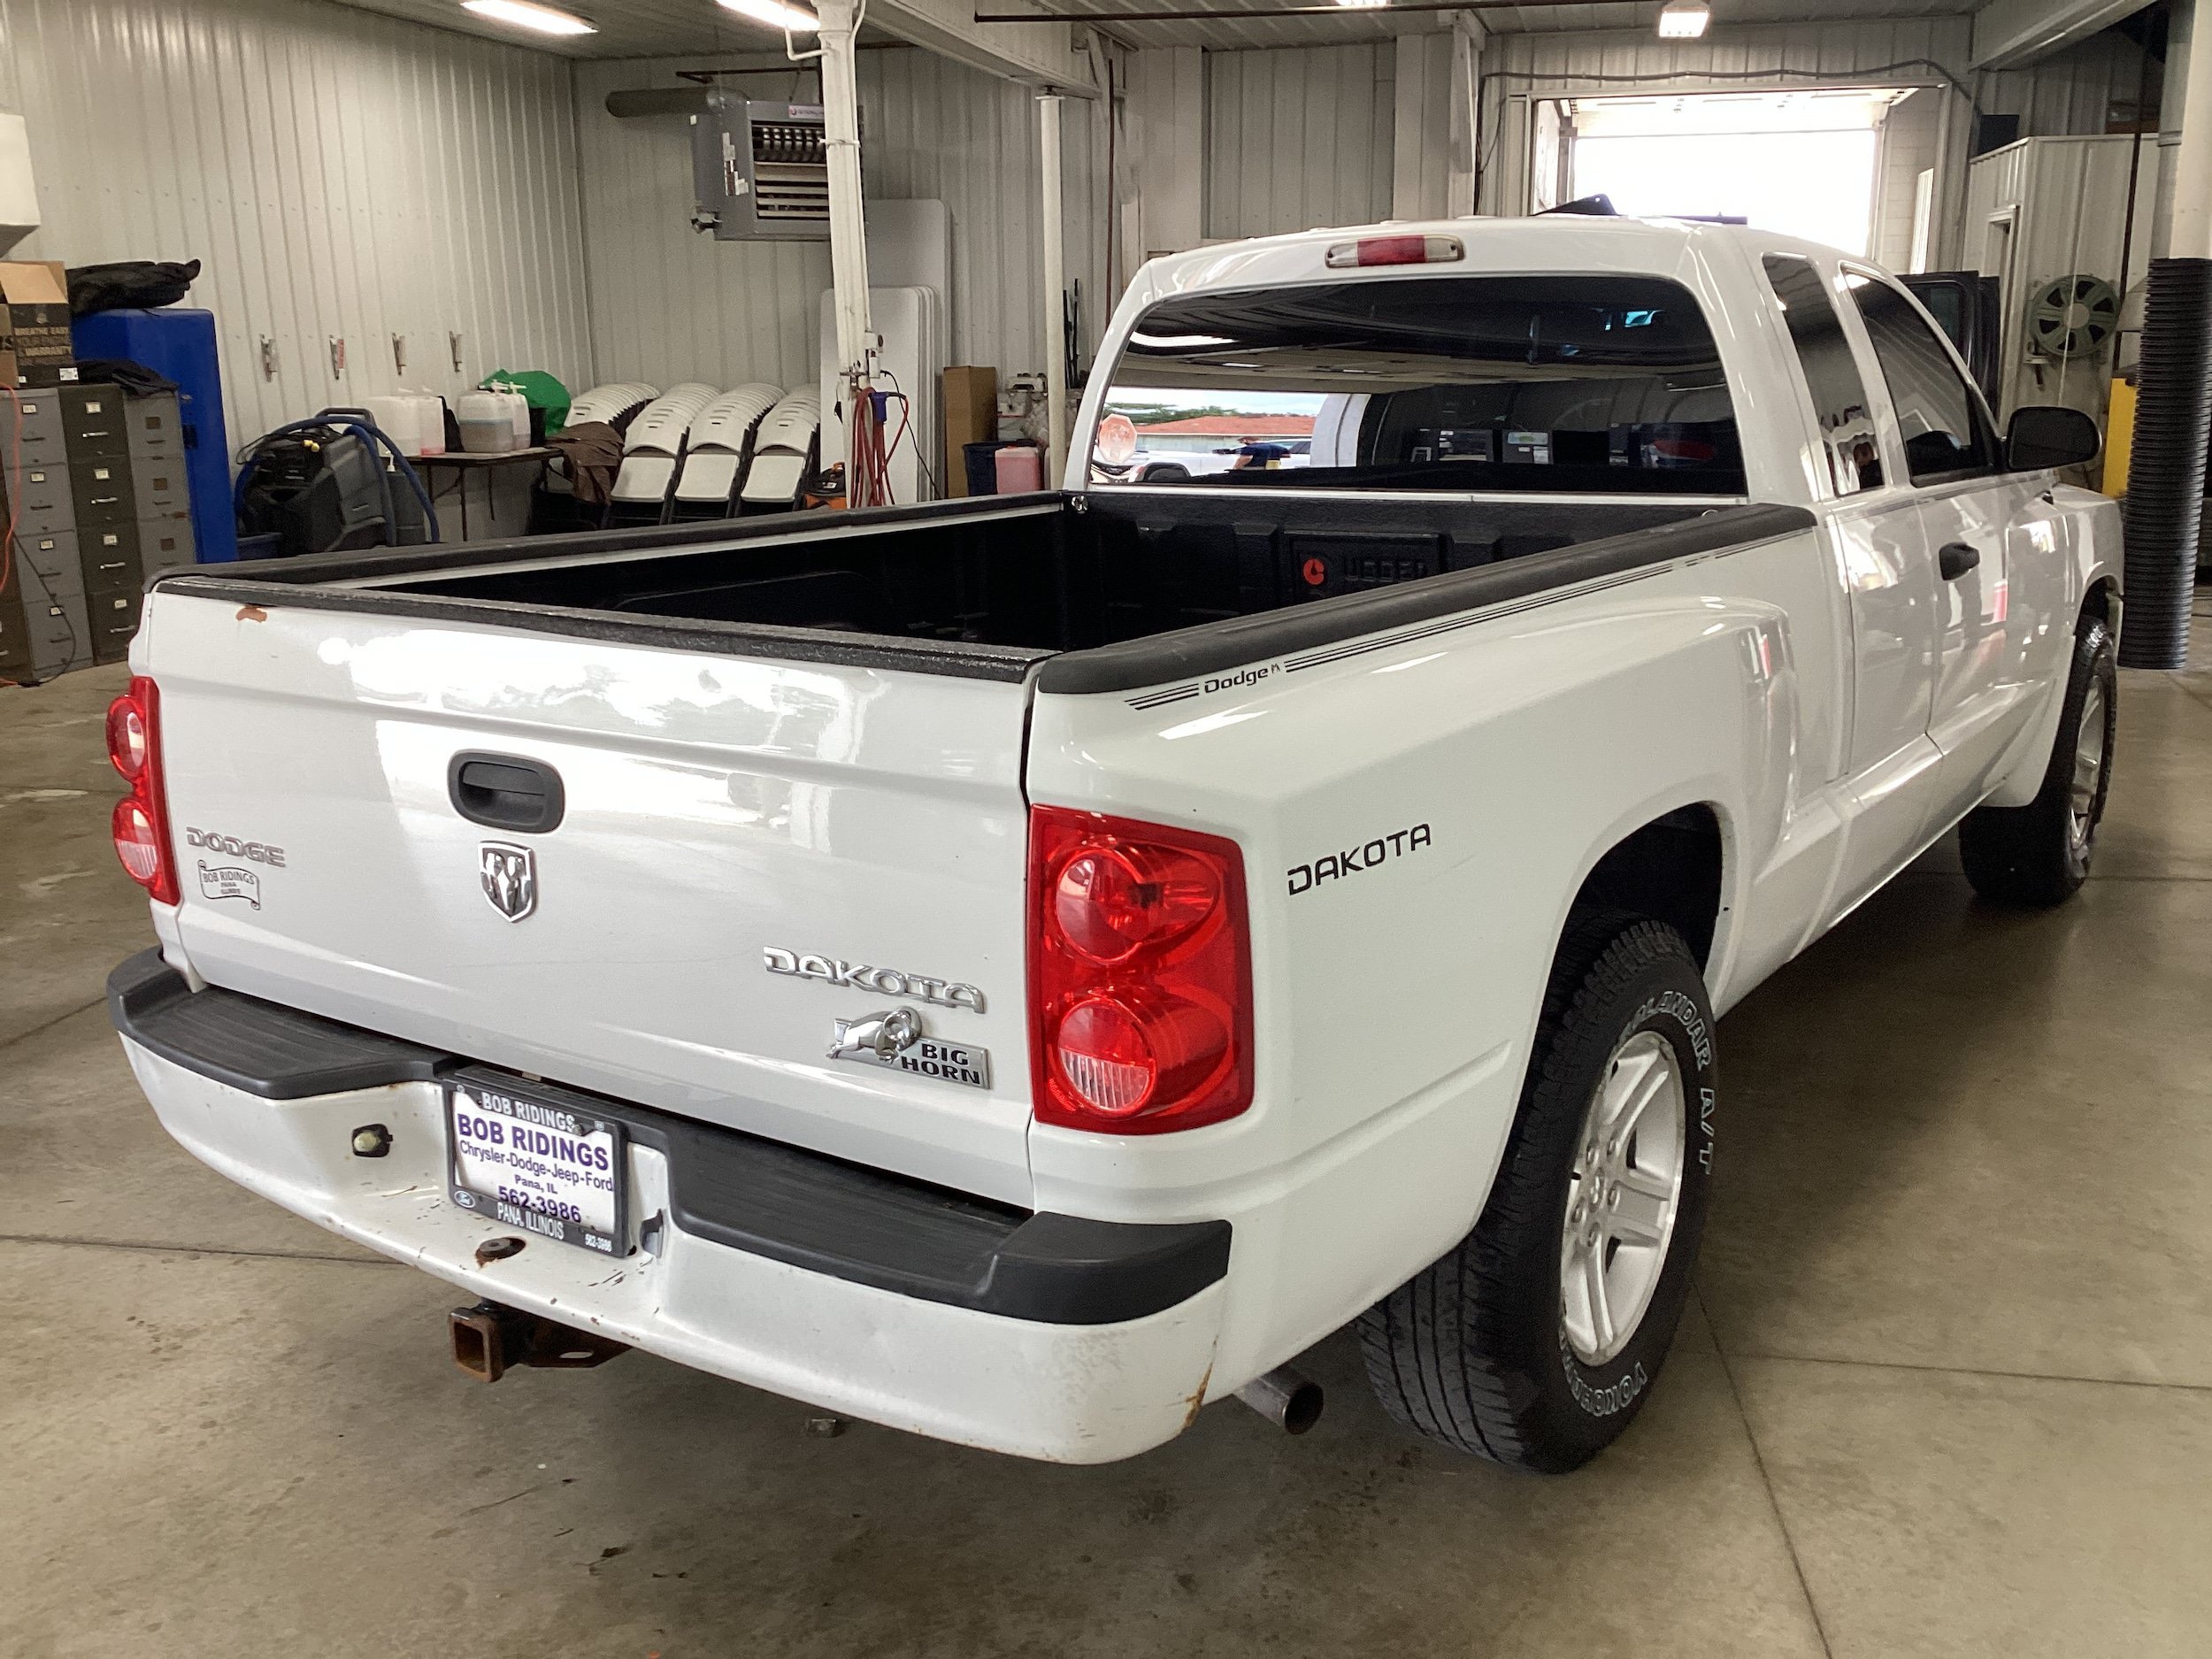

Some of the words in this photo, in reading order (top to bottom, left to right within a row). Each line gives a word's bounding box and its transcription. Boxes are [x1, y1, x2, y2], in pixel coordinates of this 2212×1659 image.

[1204, 668, 1269, 694] Dodge
[186, 826, 286, 868] DODGE
[1286, 823, 1432, 895] DAKOTA
[203, 872, 219, 883] BOB
[219, 871, 255, 885] RIDINGS
[764, 946, 987, 1014] DAKOTA
[901, 1056, 980, 1085] HORN
[921, 1042, 969, 1065] BIG
[480, 1092, 512, 1115] BOB
[514, 1101, 576, 1133] RIDINGS
[1699, 1087, 1715, 1175] A/T
[457, 1113, 504, 1145] BOB
[511, 1125, 609, 1171] RIDINGS
[514, 1174, 545, 1193] Pana,
[547, 1182, 558, 1194] IL
[498, 1185, 582, 1223] 562-3986
[526, 1210, 565, 1240] ILLINOIS
